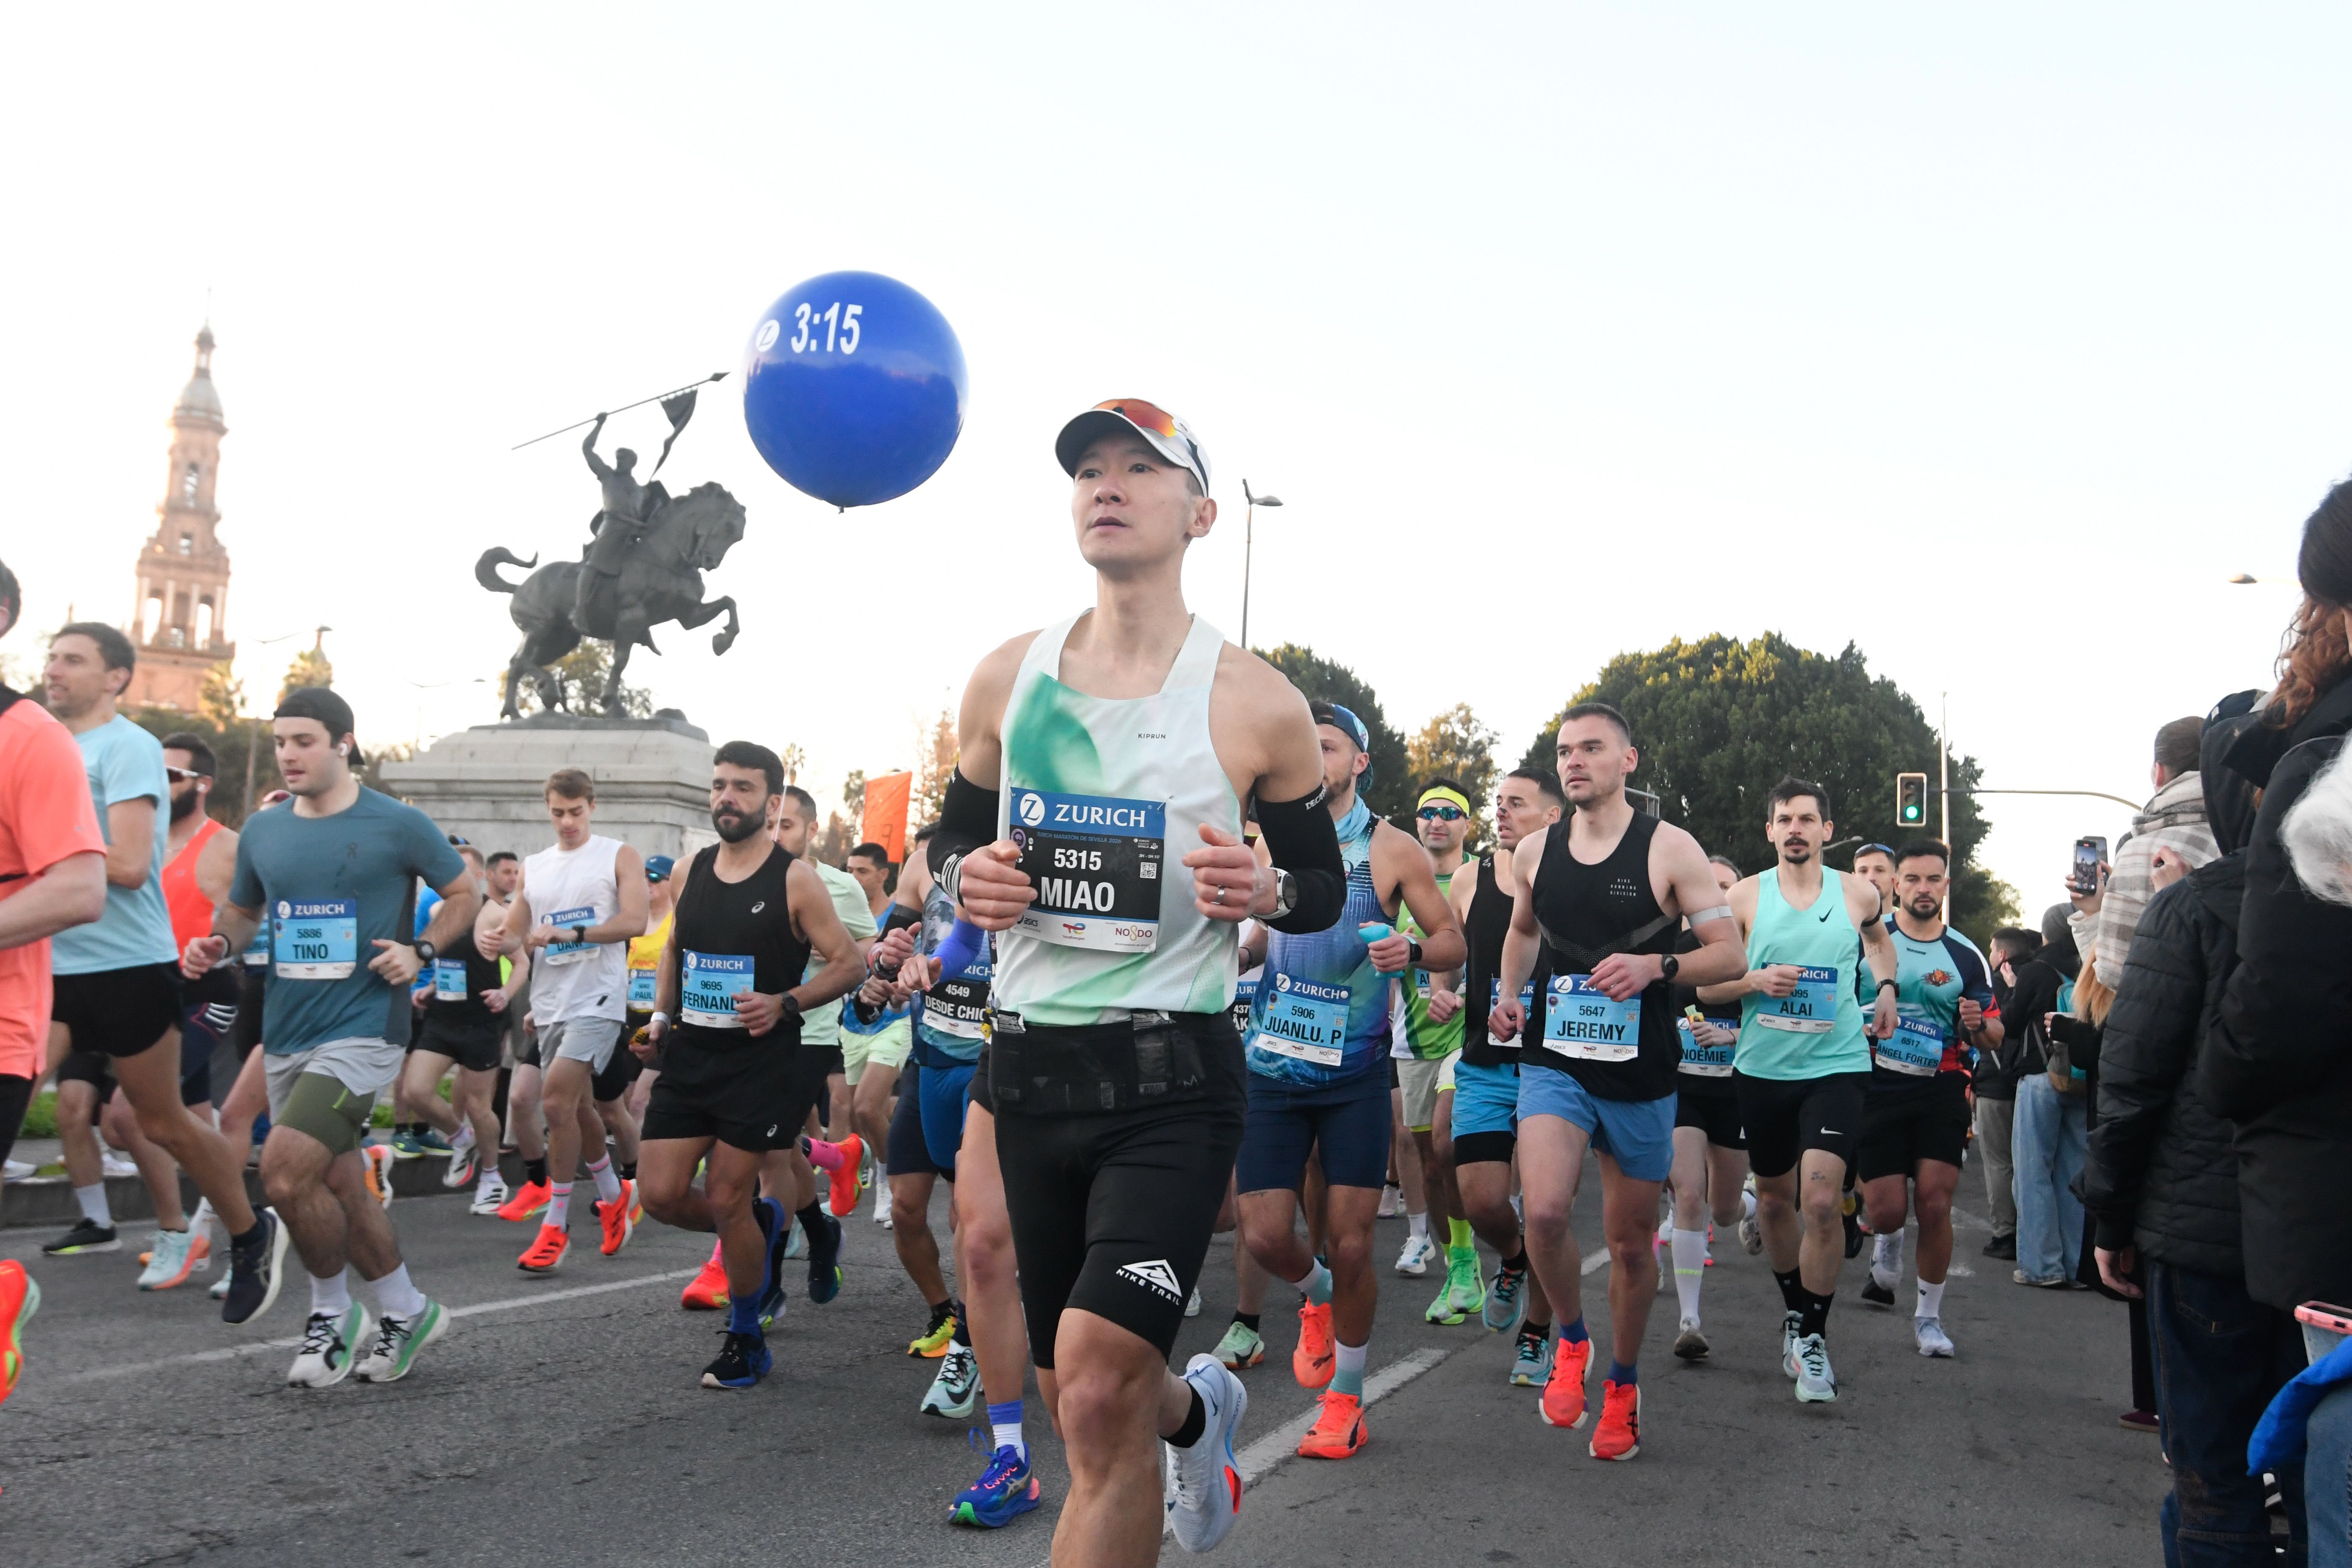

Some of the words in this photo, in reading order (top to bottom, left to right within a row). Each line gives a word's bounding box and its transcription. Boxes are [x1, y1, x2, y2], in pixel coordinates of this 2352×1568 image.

[791, 302, 863, 355] 3:15
[1054, 804, 1146, 828] ZURICH
[1054, 848, 1102, 871] 5315
[1041, 876, 1115, 912] MIAO
[294, 904, 345, 915] ZURICH
[555, 910, 588, 922] ZURICH
[1024, 918, 1038, 927] asics
[293, 943, 328, 959] TINO
[700, 958, 743, 970] ZURICH
[700, 980, 722, 991] 9695
[945, 984, 970, 997] 4549
[1293, 982, 1340, 999] ZURICH
[635, 991, 653, 999] PAUL
[1790, 989, 1808, 998] 095
[925, 995, 955, 1016] DESDE
[1291, 1005, 1315, 1019] 5906
[1579, 1005, 1605, 1017] 5647
[1780, 1001, 1812, 1016] ALAI
[1265, 1016, 1324, 1043] JUANLU.
[1331, 1029, 1342, 1044] P
[1557, 1021, 1625, 1041] JEREMY
[1904, 1021, 1936, 1037] ZURICH
[1901, 1037, 1920, 1048] 6517
[1906, 1053, 1939, 1067] FORTES
[1116, 1269, 1146, 1286] NIKE
[1151, 1284, 1179, 1306] TRAIL
